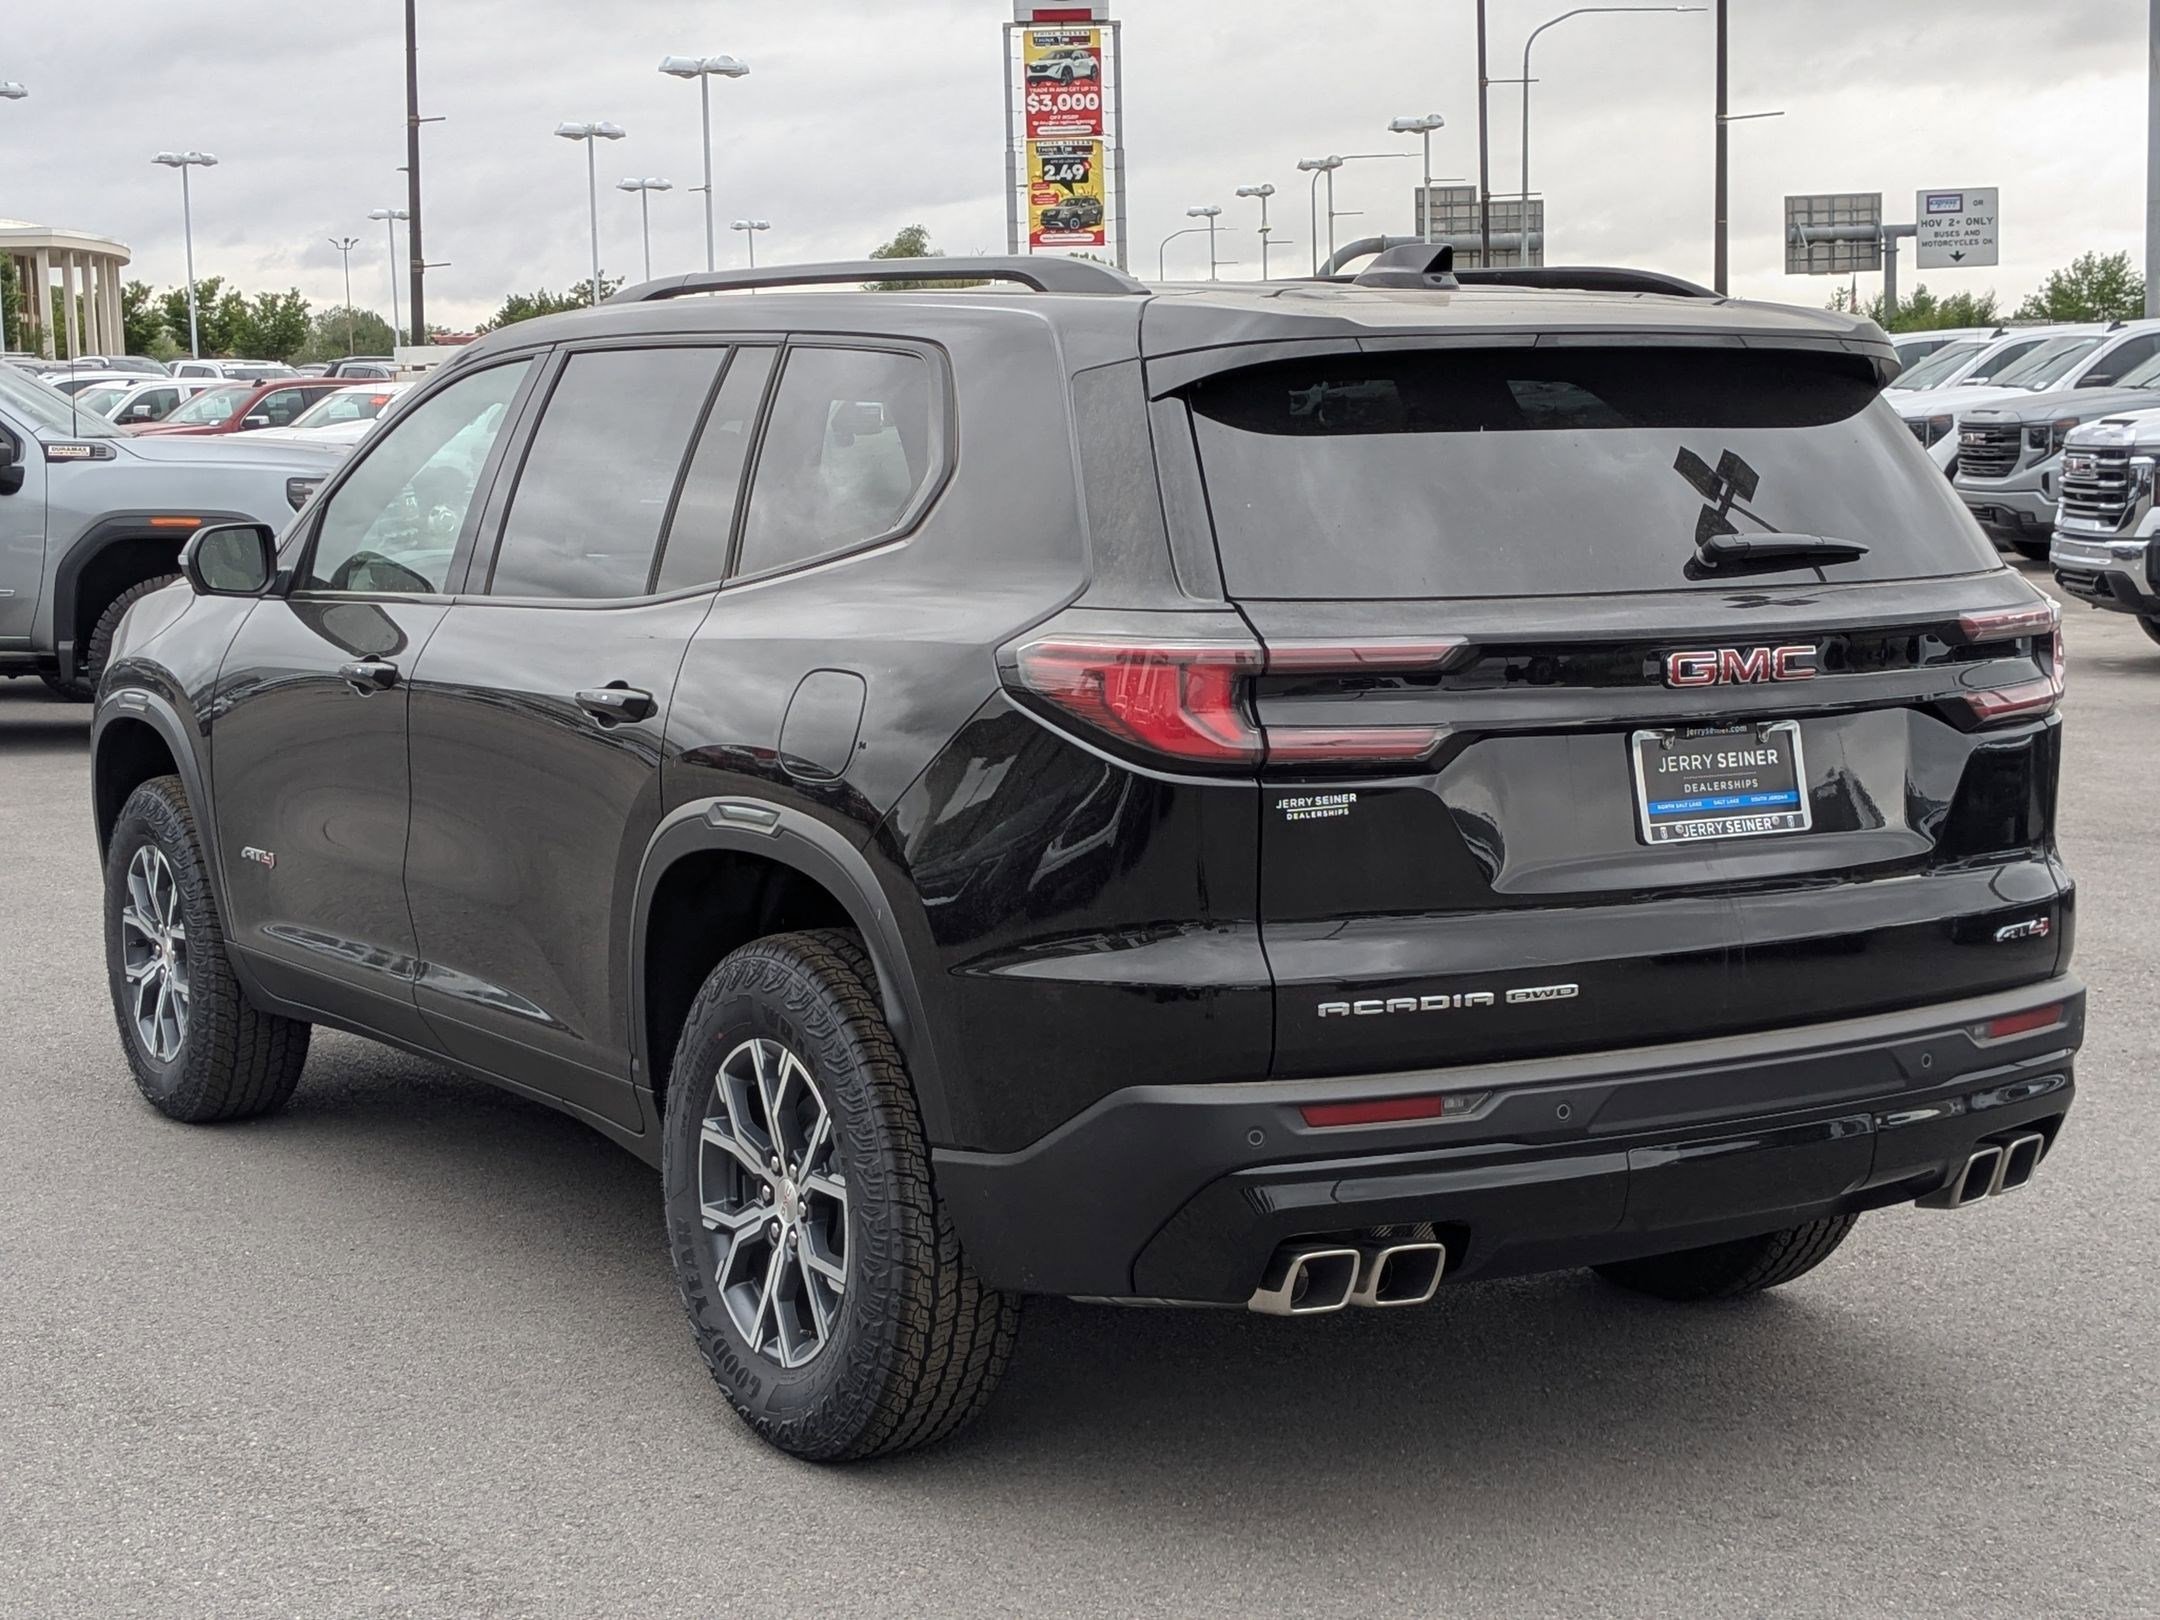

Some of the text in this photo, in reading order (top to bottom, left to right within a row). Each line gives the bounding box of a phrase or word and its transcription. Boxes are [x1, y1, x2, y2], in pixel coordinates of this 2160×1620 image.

[1027, 93, 1099, 114] $3,000
[1044, 164, 1084, 180] 2.49
[1921, 219, 1942, 227] HOV
[1966, 217, 1993, 225] ONLY
[1934, 230, 1960, 238] BUSES
[1922, 239, 1979, 247] MOTORCYCLES
[1667, 645, 1816, 687] GMC
[1658, 749, 1779, 773] JERRY SEINER
[1684, 778, 1759, 793] DEALERSHIPS
[1276, 793, 1357, 809] JERRY SEINER
[1286, 808, 1349, 820] DEALERSHIPS
[1683, 818, 1772, 837] JERRY SEINER
[1318, 987, 1575, 1017] ACADIA AWD
